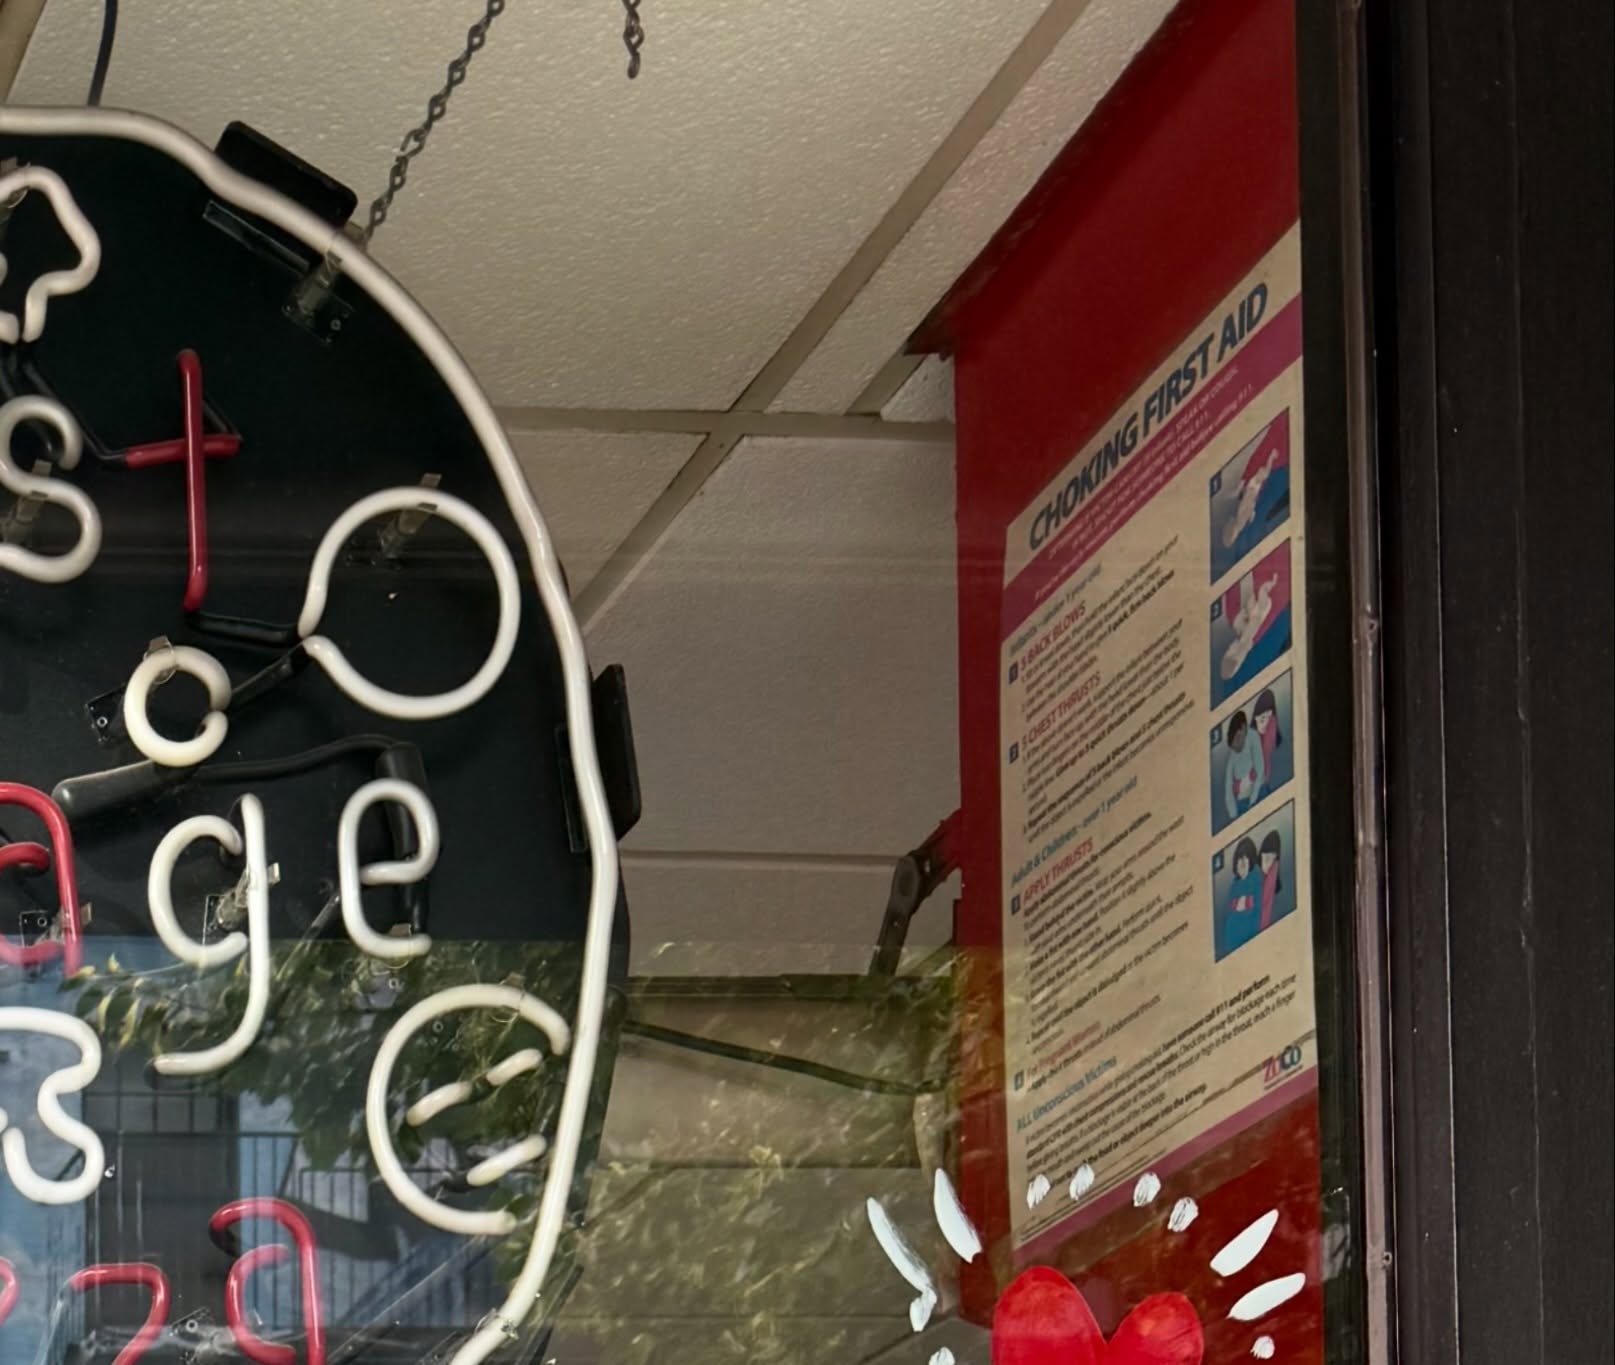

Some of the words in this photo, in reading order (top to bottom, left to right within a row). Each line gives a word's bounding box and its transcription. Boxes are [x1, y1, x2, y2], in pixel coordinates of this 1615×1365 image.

[1029, 414, 1139, 552] CHOKING
[1142, 334, 1215, 437] FIRST
[1216, 281, 1268, 362] AID
[1028, 634, 1051, 664] BACK
[1052, 602, 1086, 642] BLOWS
[1028, 711, 1056, 744] CHEST
[1057, 672, 1100, 720] THRUSTS
[1023, 872, 1049, 906] APPLY
[1052, 838, 1092, 881] THRUSTS
